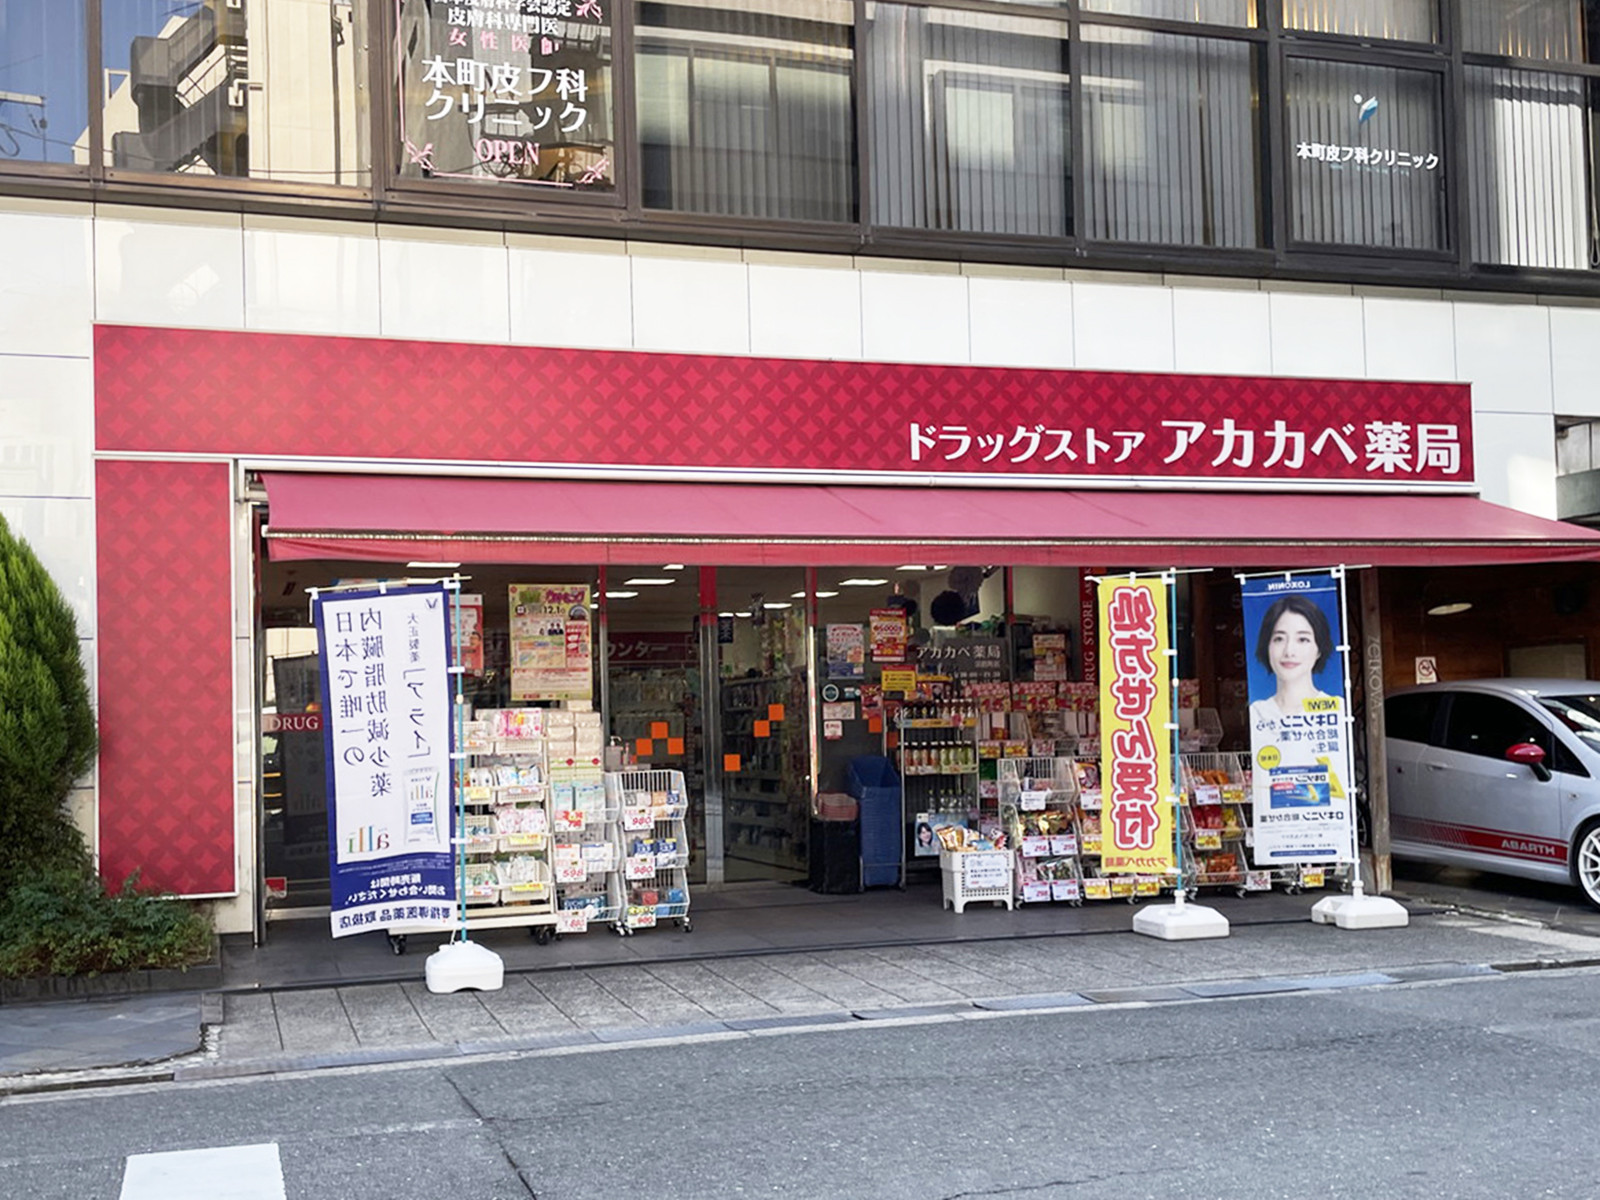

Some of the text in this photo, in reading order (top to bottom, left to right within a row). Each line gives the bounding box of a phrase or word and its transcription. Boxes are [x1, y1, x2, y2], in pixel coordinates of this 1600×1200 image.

[448, 8, 559, 35] 皮膚科専門医
[421, 55, 589, 102] 本町皮フ科
[425, 90, 588, 133] クリニック
[475, 138, 540, 165] OPEN
[1296, 141, 1439, 170] 本町皮フ科クリニック
[908, 418, 1462, 475] ドラッグストア アカカベ薬局
[1082, 600, 1095, 645] STORE
[916, 644, 1002, 659] アカカベ薬局
[1084, 651, 1095, 686] RUG
[269, 715, 319, 730] DRUG
[1501, 839, 1556, 856] ABARTH
